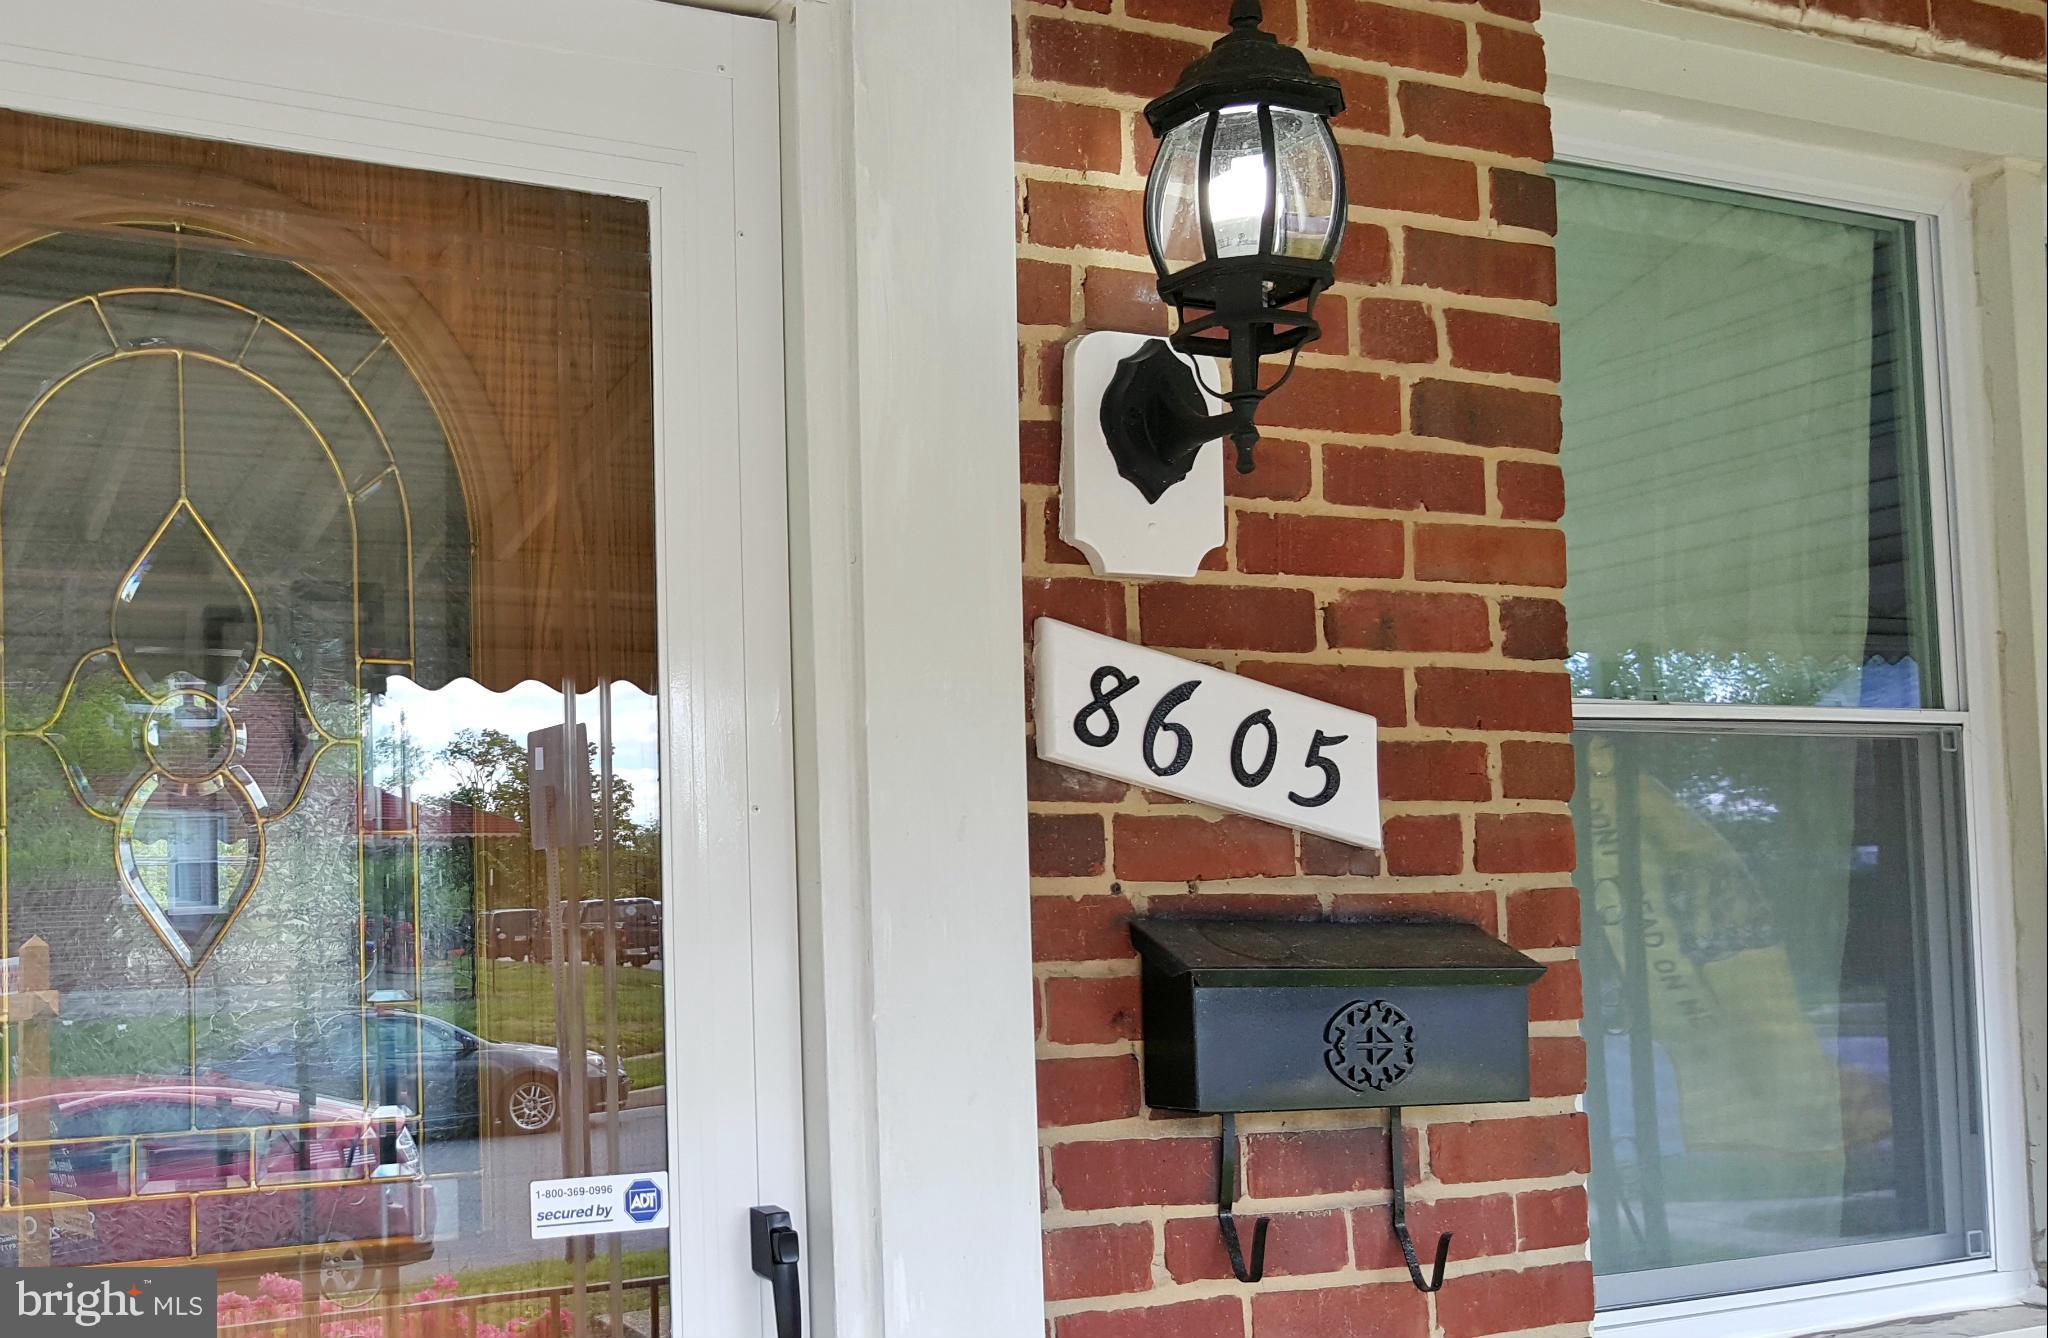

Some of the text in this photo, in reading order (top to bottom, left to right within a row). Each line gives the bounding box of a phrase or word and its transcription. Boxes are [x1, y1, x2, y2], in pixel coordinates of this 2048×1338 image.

[1073, 665, 1349, 808] 8605
[535, 1184, 613, 1200] 1-800-369-0996
[630, 1191, 656, 1209] ADT
[536, 1204, 613, 1221] secured by
